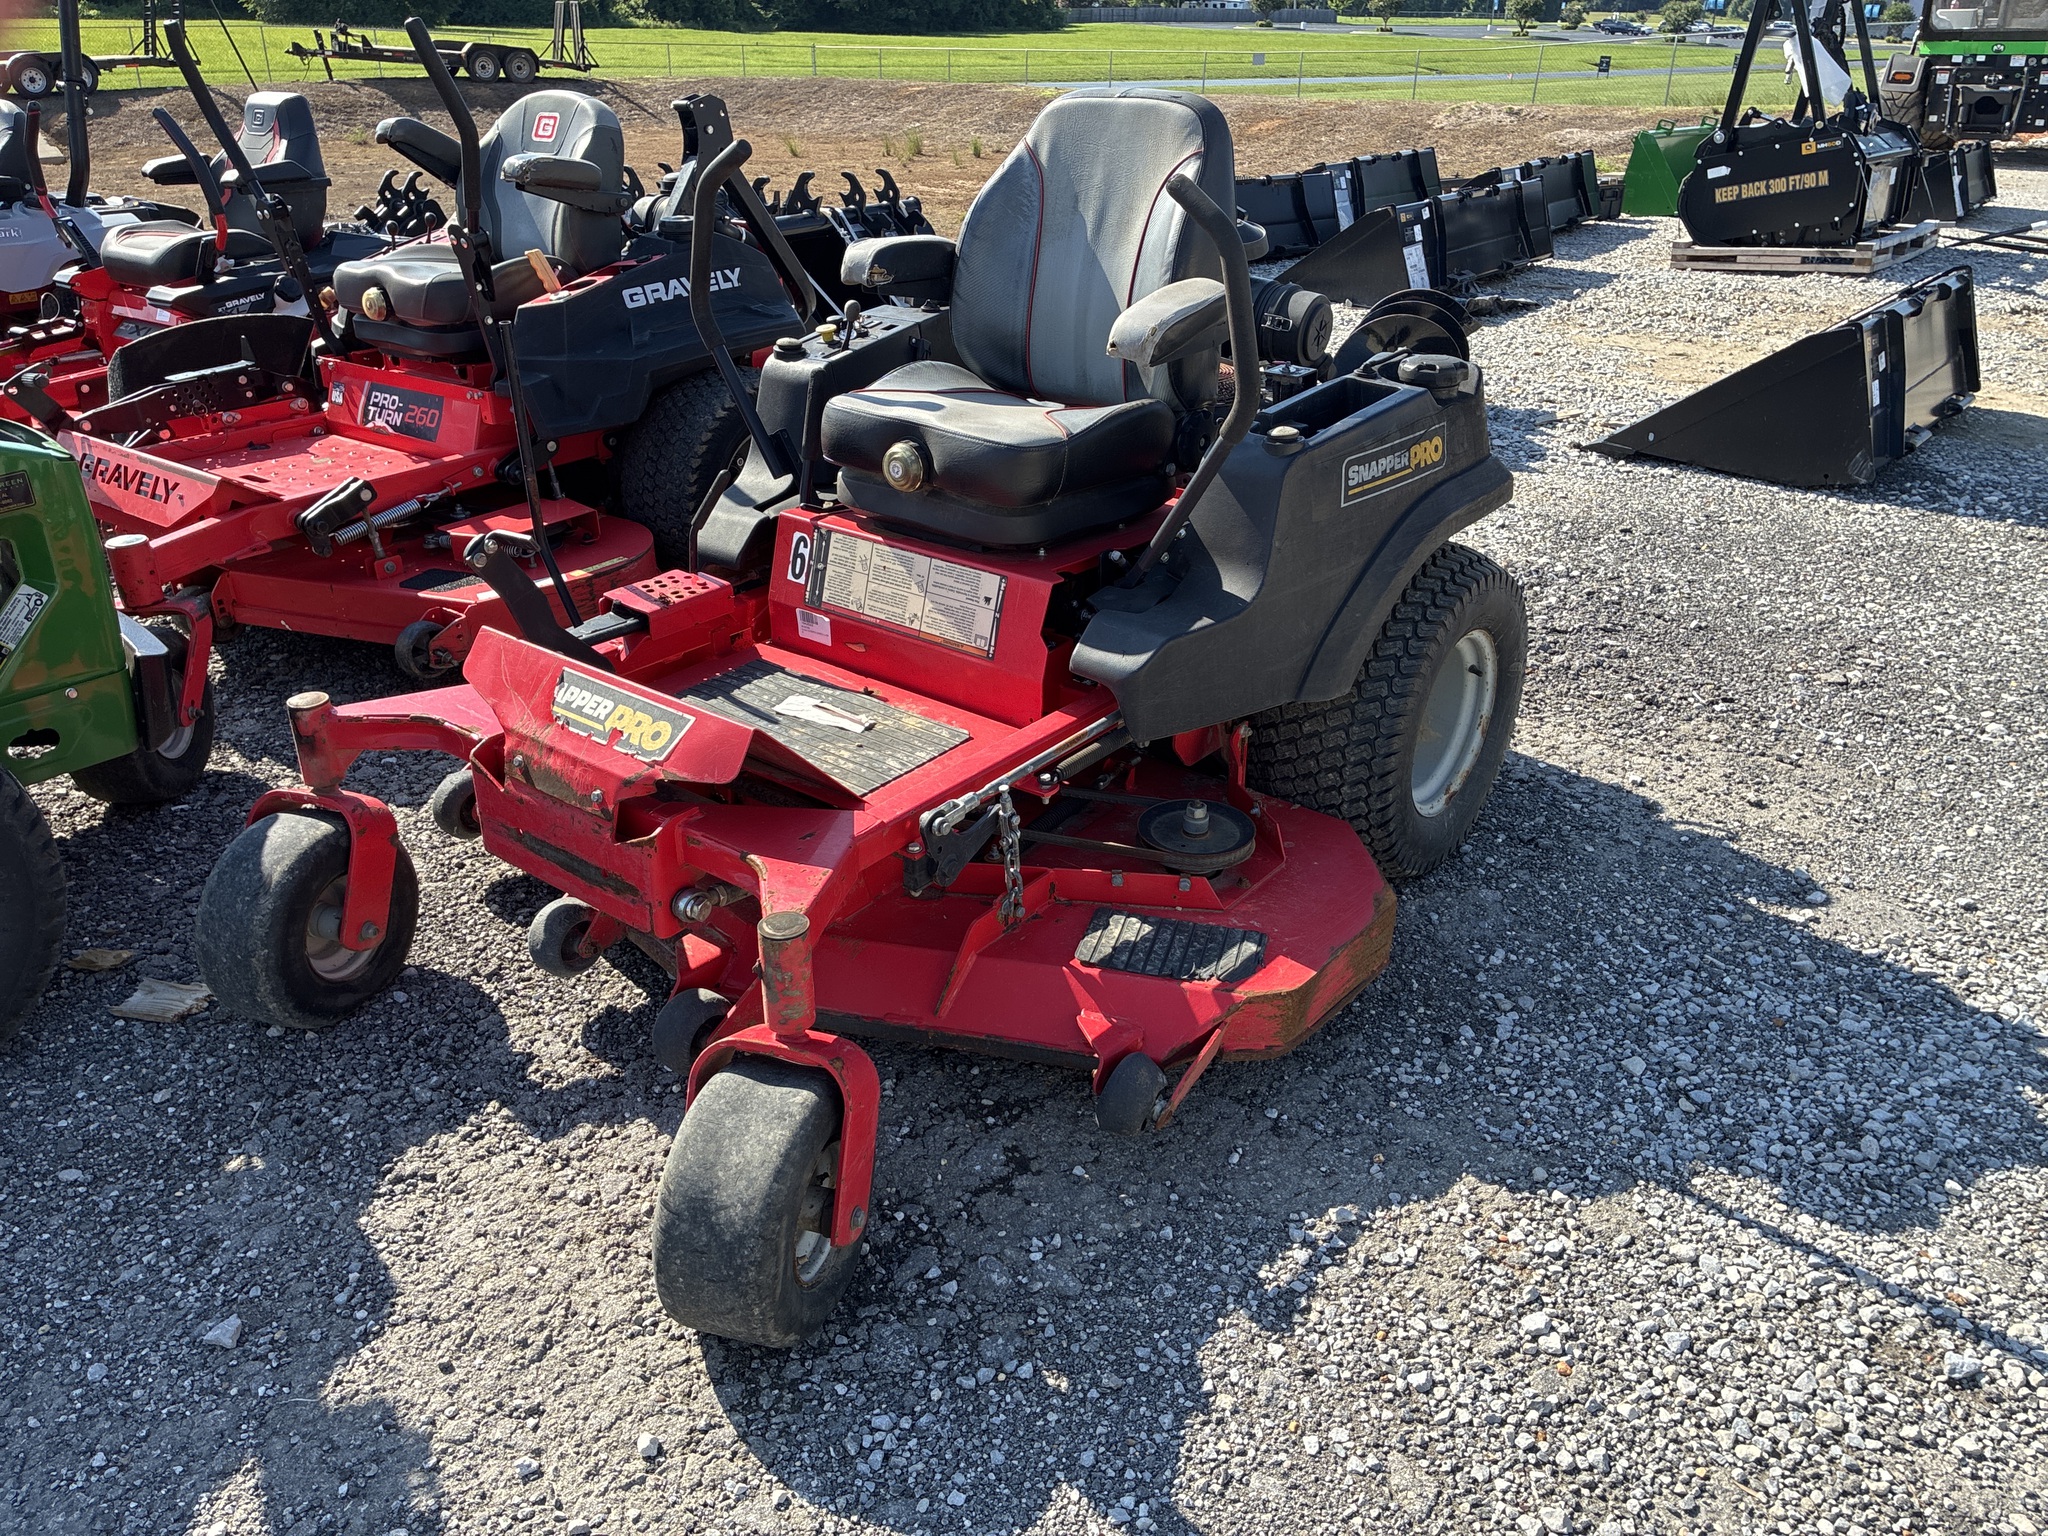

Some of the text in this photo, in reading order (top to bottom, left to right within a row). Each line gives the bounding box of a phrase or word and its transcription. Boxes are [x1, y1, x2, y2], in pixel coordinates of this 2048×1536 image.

[1715, 170, 1829, 203] KEEP BACK 300 FT/90 M
[225, 292, 265, 308] GRAVELY
[368, 404, 440, 428] TURN 260
[369, 391, 403, 410] PRO-
[80, 452, 180, 505] GRAVELY
[791, 535, 808, 580] 6
[604, 703, 672, 751] PRO
